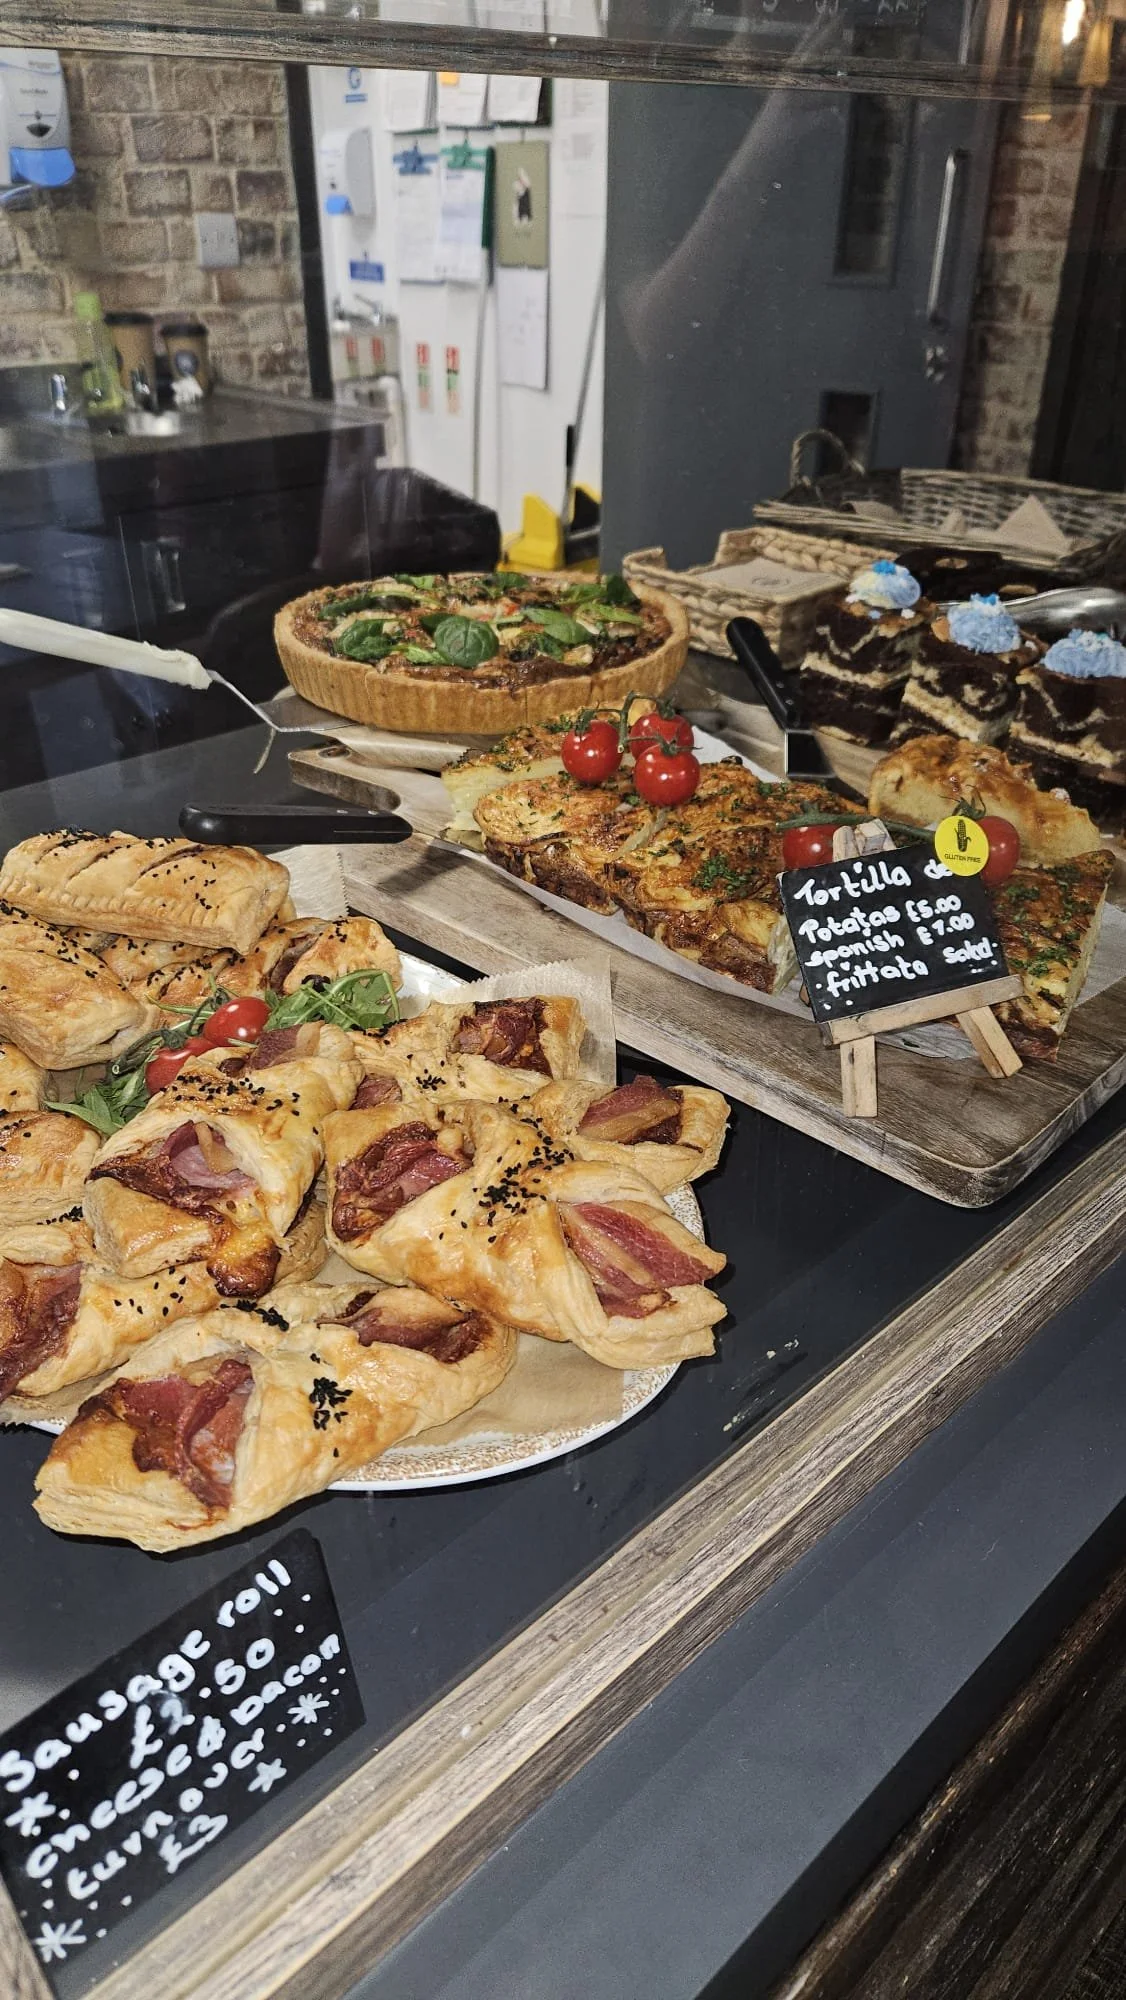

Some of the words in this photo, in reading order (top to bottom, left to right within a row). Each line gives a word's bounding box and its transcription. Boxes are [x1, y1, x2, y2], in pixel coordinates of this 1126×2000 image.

[944, 853, 967, 862] GLUTEN
[967, 856, 982, 864] FREE
[793, 860, 912, 906] Tortilla
[798, 905, 901, 944] Potatas
[904, 894, 962, 923] £5.00
[826, 954, 929, 998] frittata
[0, 1629, 211, 1793] Sausage
[216, 1558, 292, 1628] roll
[158, 1814, 229, 1875] £3
